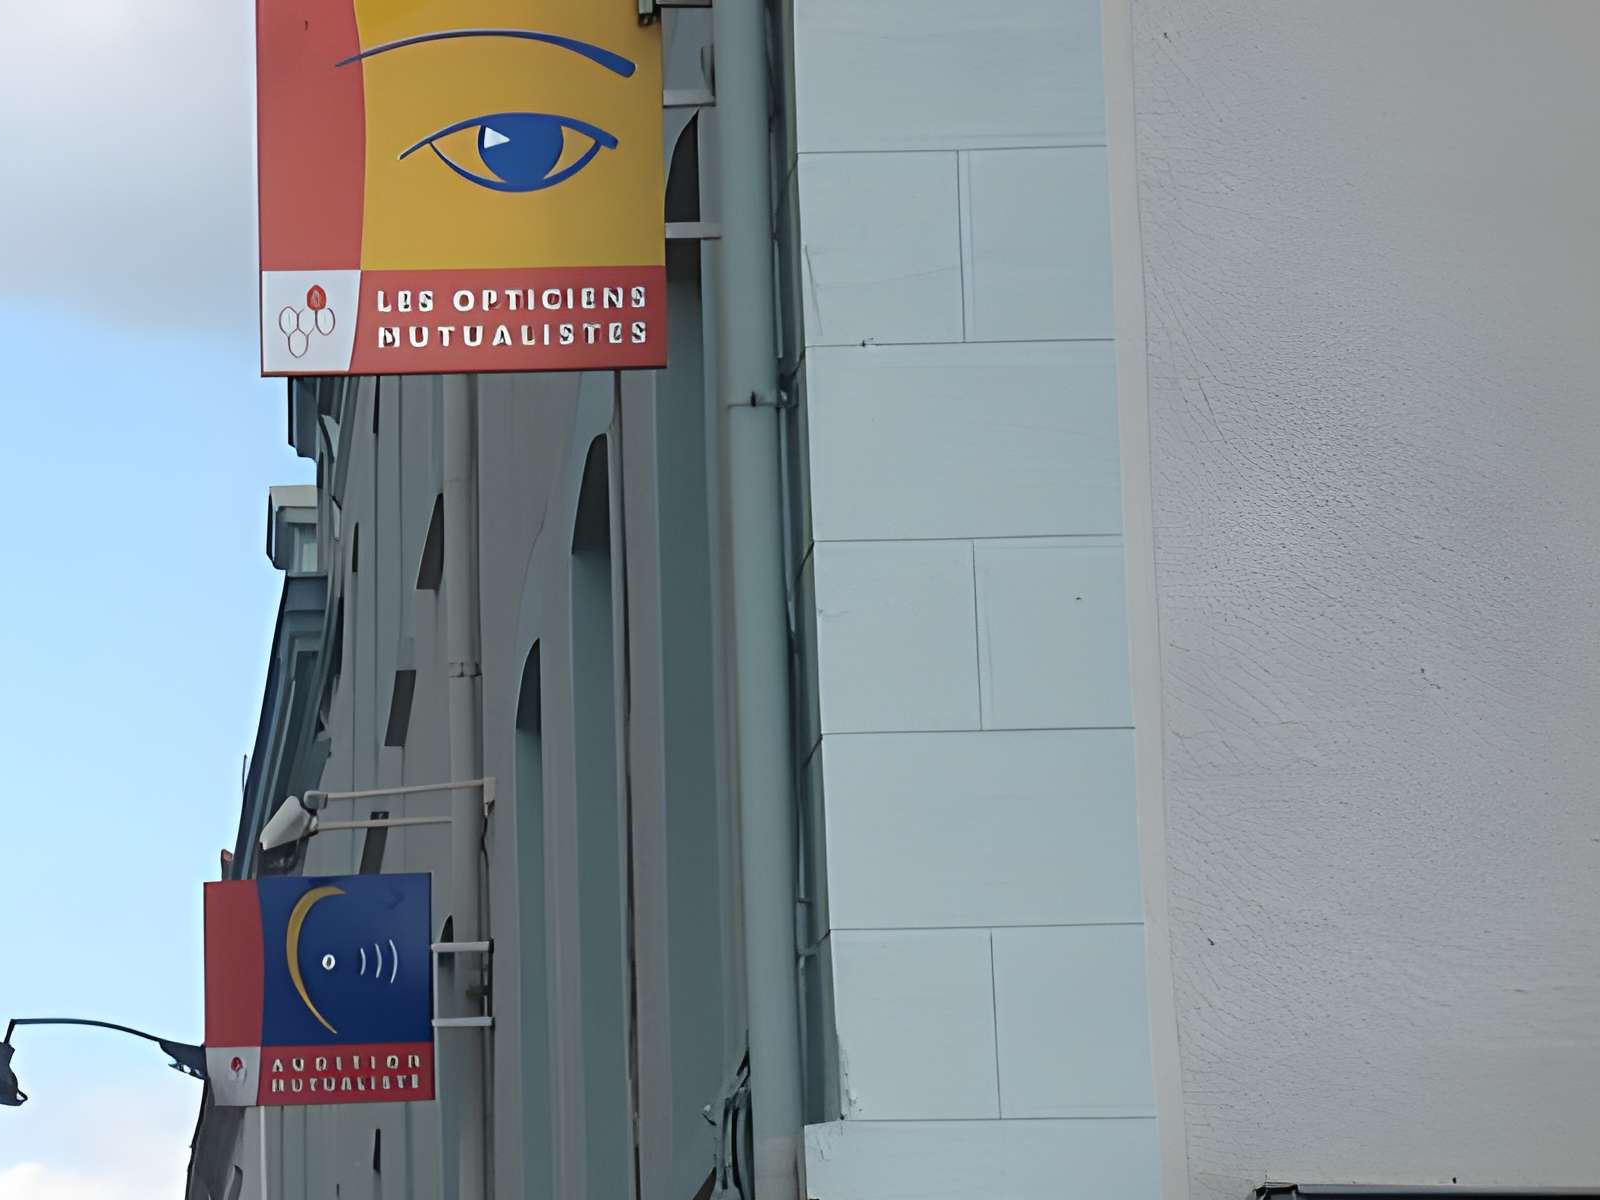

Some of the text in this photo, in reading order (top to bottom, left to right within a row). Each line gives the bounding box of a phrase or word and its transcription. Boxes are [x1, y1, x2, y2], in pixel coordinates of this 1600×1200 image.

[377, 286, 647, 313] LES OPTICIENS
[377, 321, 647, 348] MUTUALISTES
